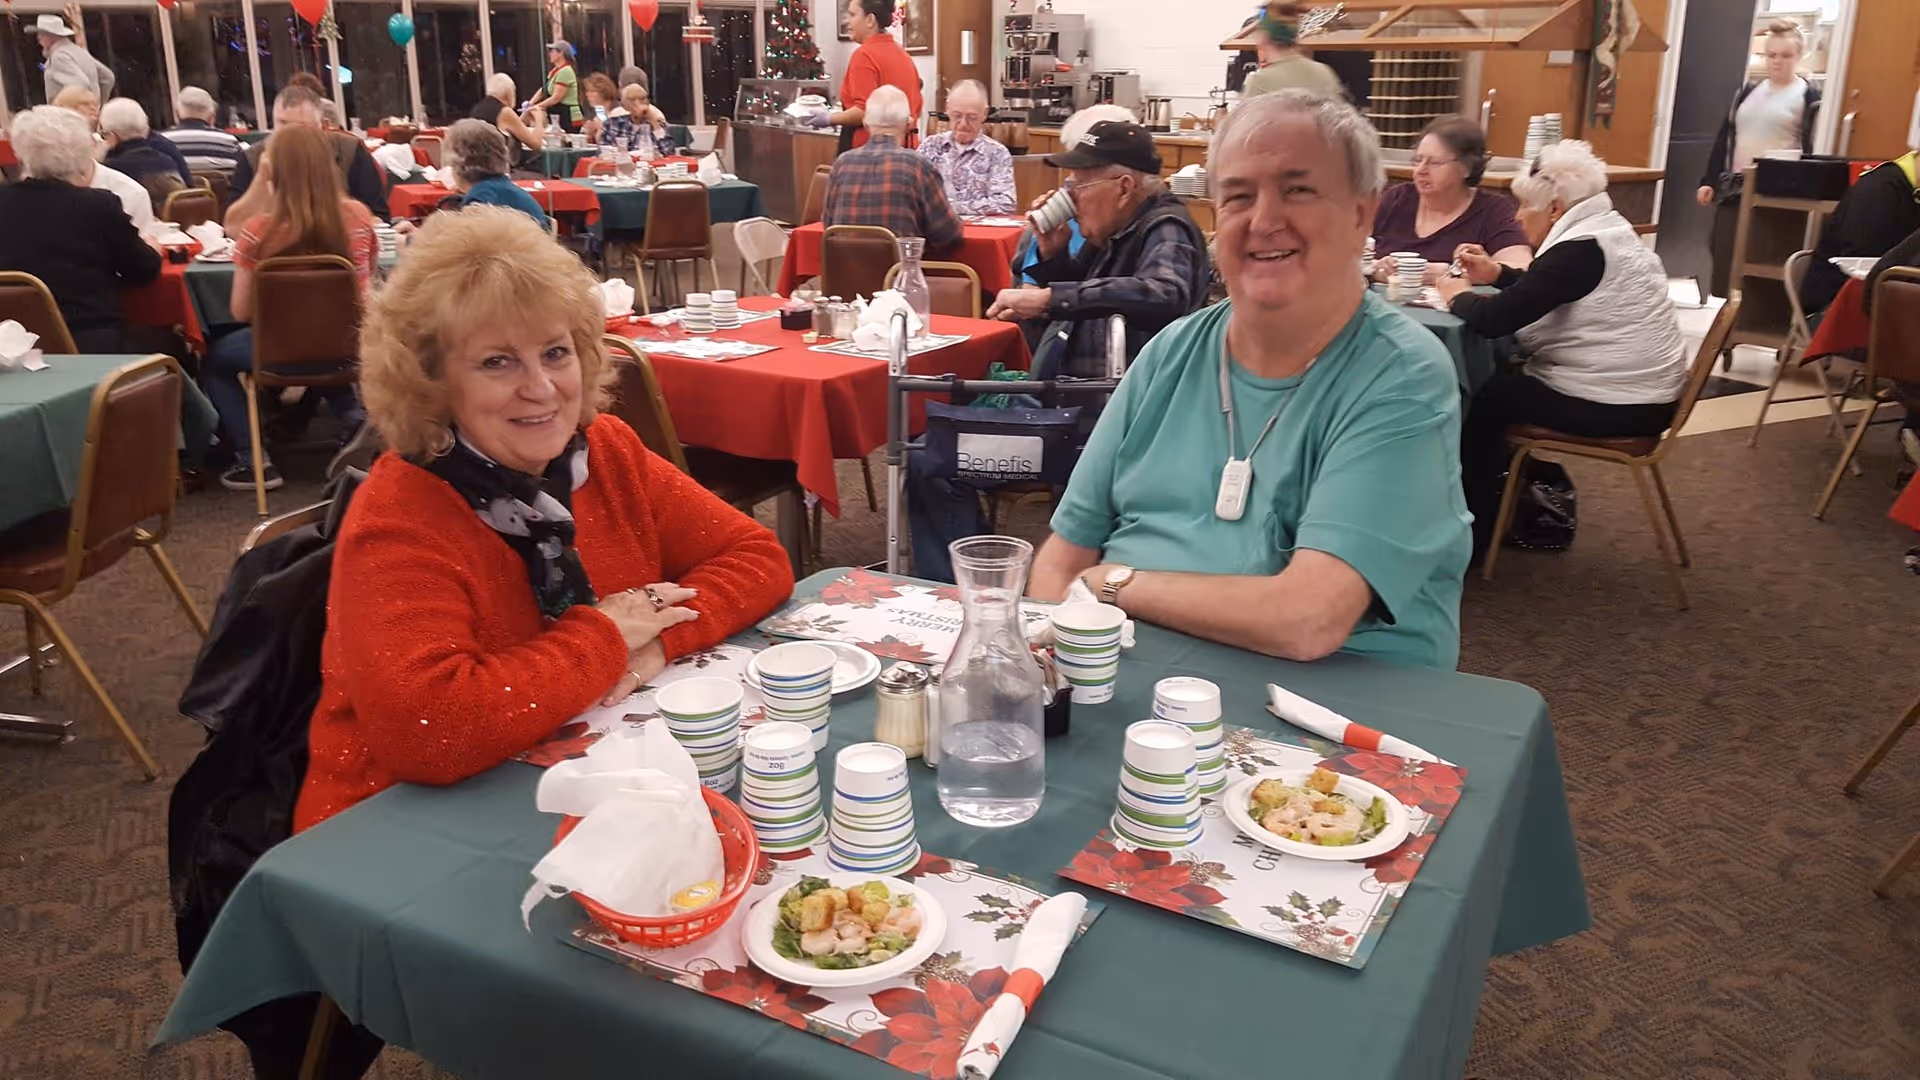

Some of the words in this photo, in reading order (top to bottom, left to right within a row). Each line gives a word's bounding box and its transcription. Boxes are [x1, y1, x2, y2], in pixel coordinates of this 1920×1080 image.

[956, 452, 1032, 472] Benefis
[888, 608, 963, 625] RISTMAS
[889, 616, 960, 633] MERRY
